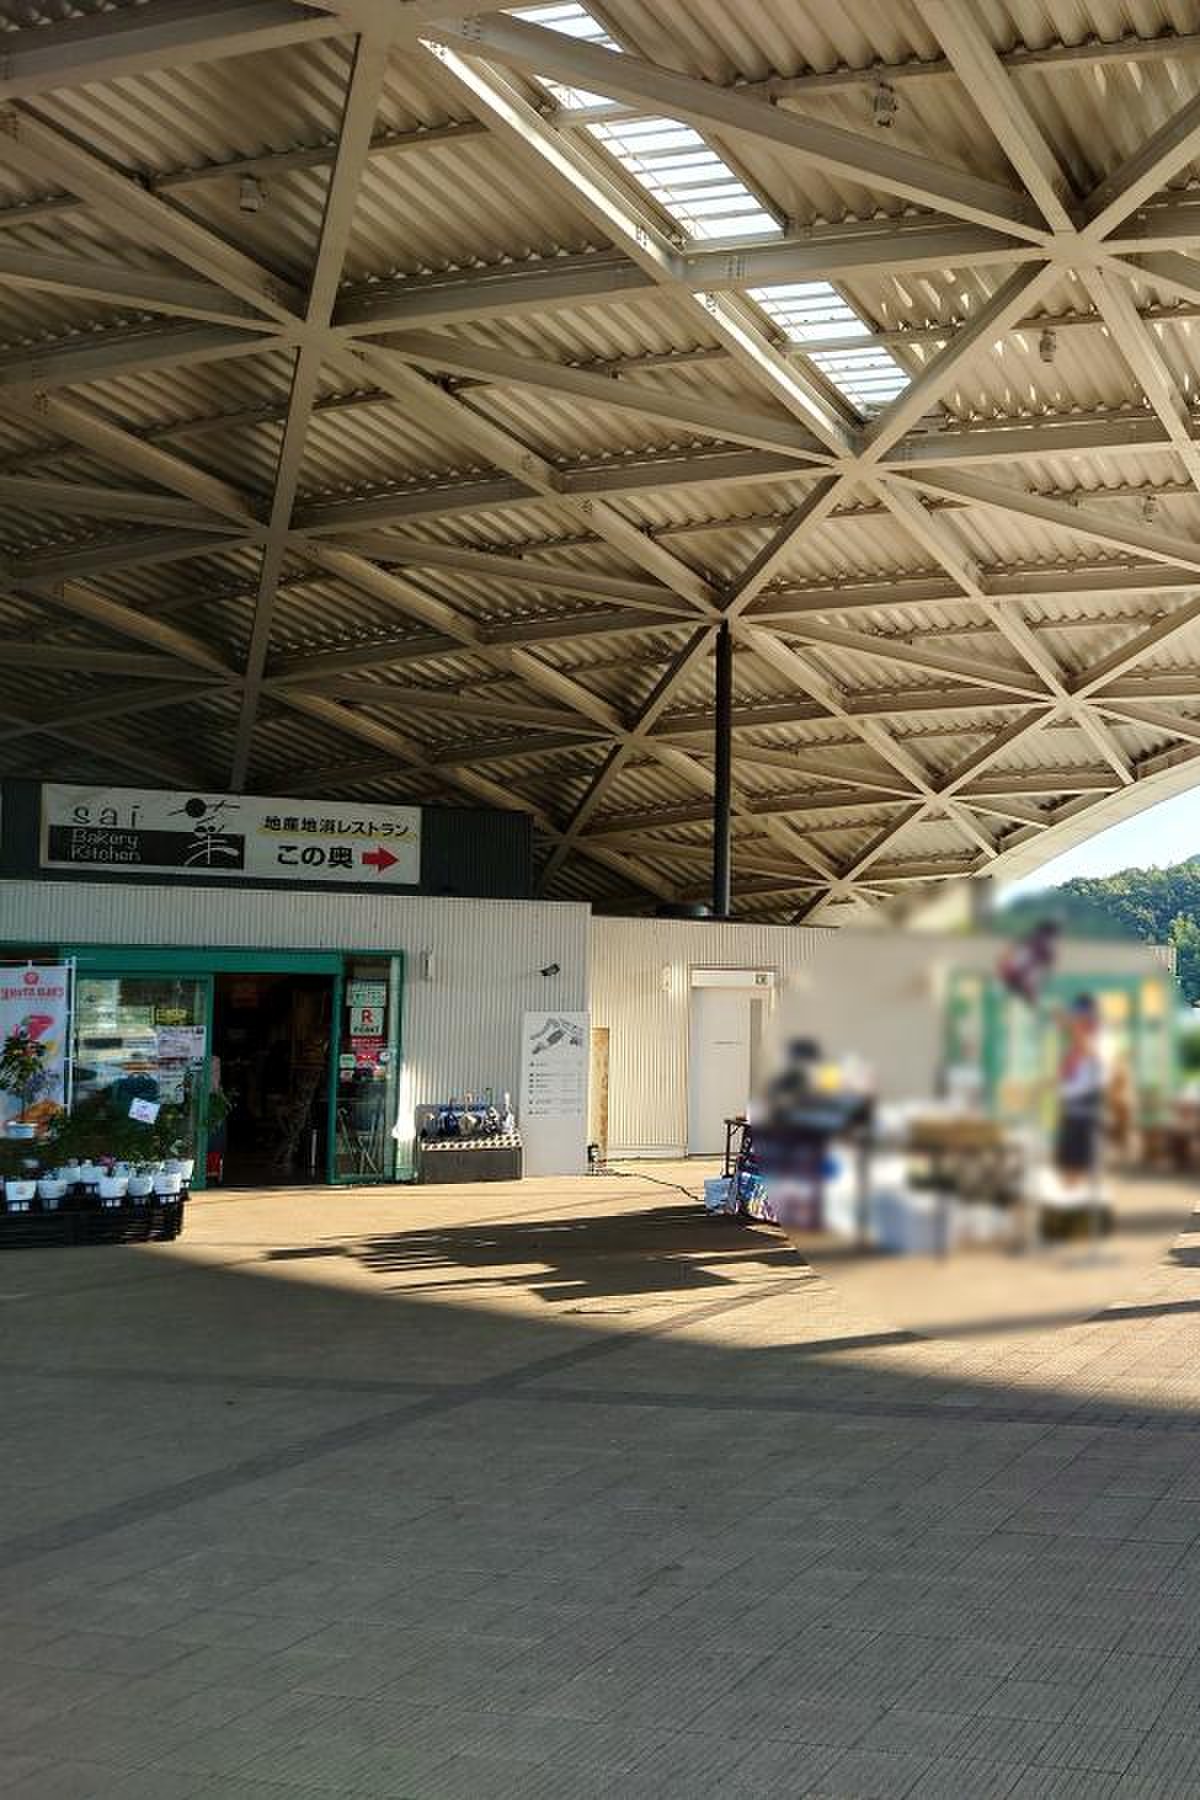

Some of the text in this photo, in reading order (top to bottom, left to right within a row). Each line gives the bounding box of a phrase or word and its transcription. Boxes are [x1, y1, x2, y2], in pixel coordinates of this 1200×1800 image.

[72, 804, 140, 827] sai
[264, 815, 409, 837] 地産地消レストラン
[72, 829, 140, 848] Bakery
[71, 844, 141, 862] Kitchen
[277, 845, 353, 869] この奥
